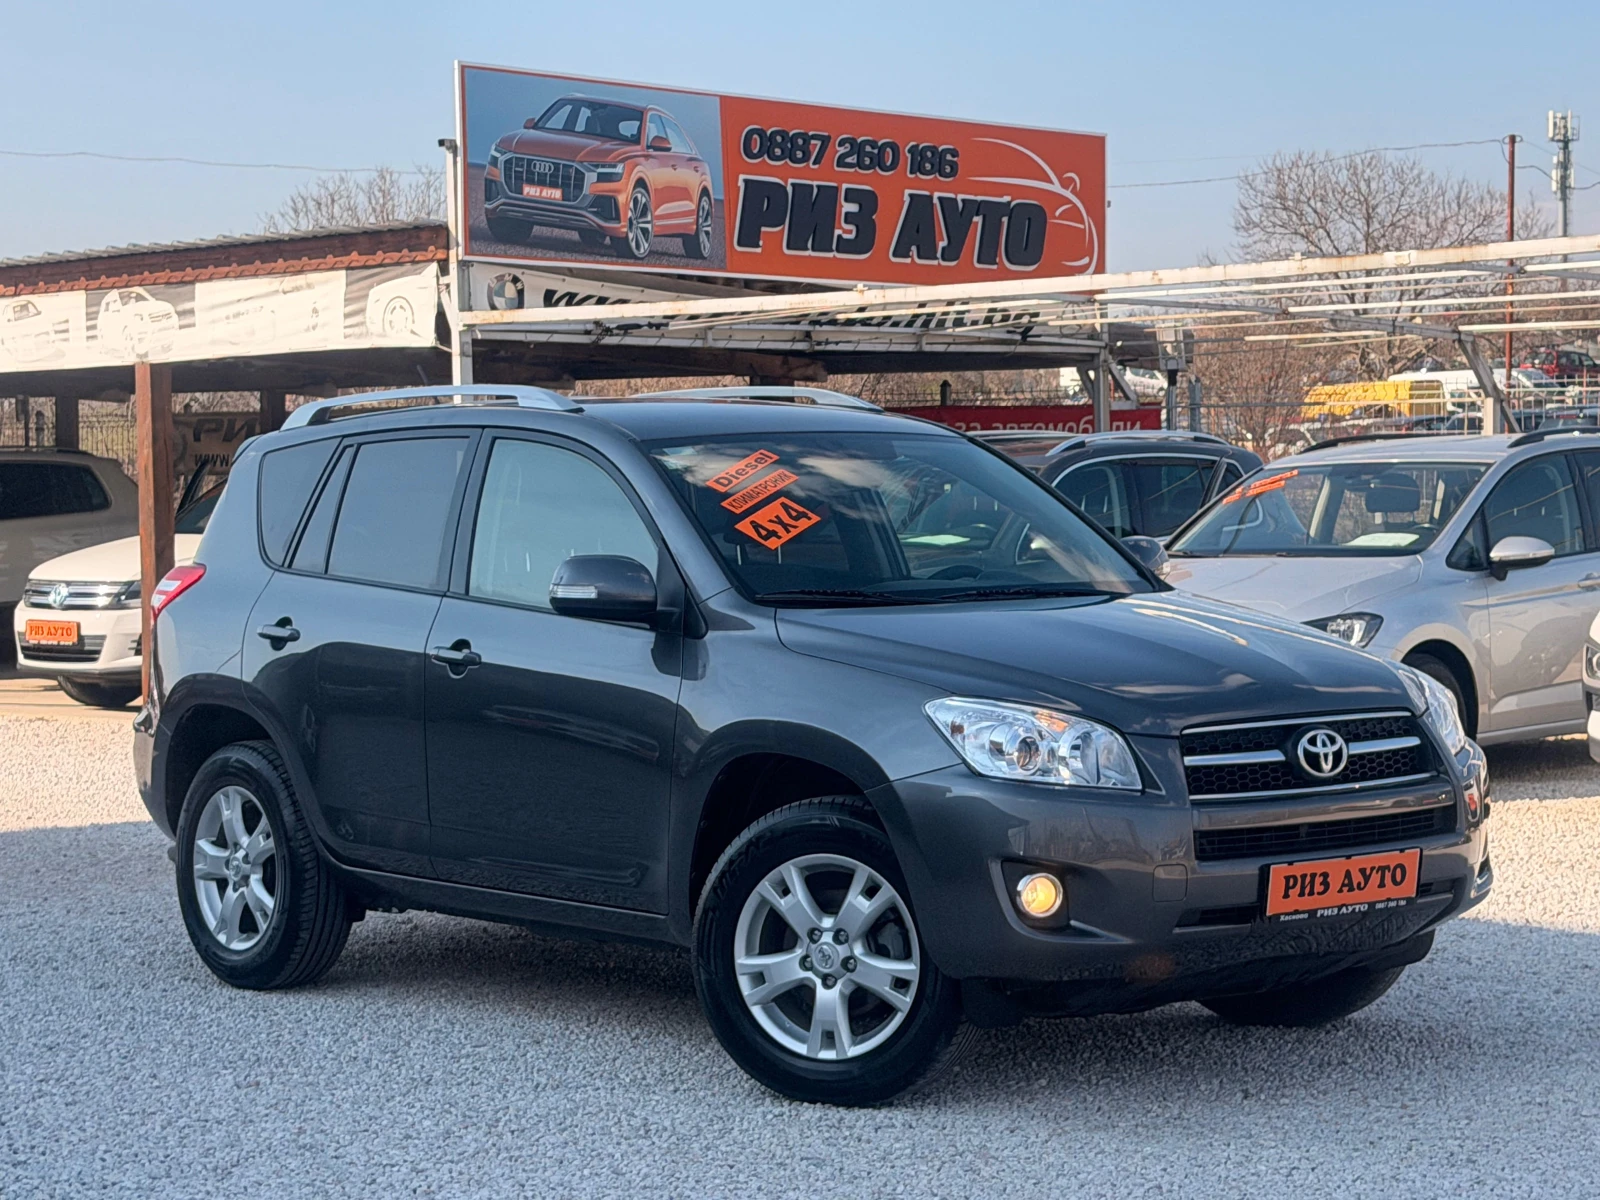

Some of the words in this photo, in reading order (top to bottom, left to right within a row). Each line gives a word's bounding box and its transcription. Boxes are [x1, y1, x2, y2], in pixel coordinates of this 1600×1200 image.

[741, 125, 832, 169] 0887
[834, 135, 901, 176] 260
[906, 142, 960, 181] 186
[734, 175, 879, 260] РИЗ
[889, 189, 1048, 271] АУТО
[713, 452, 774, 488] Diesel
[727, 470, 793, 510] КЛИМАТРОНИК
[47, 626, 73, 637] АУТО
[1282, 871, 1330, 900] РИЗ
[1337, 863, 1407, 893] АУТО
[1316, 907, 1339, 918] РИЗ
[1340, 903, 1369, 915] АУТО
